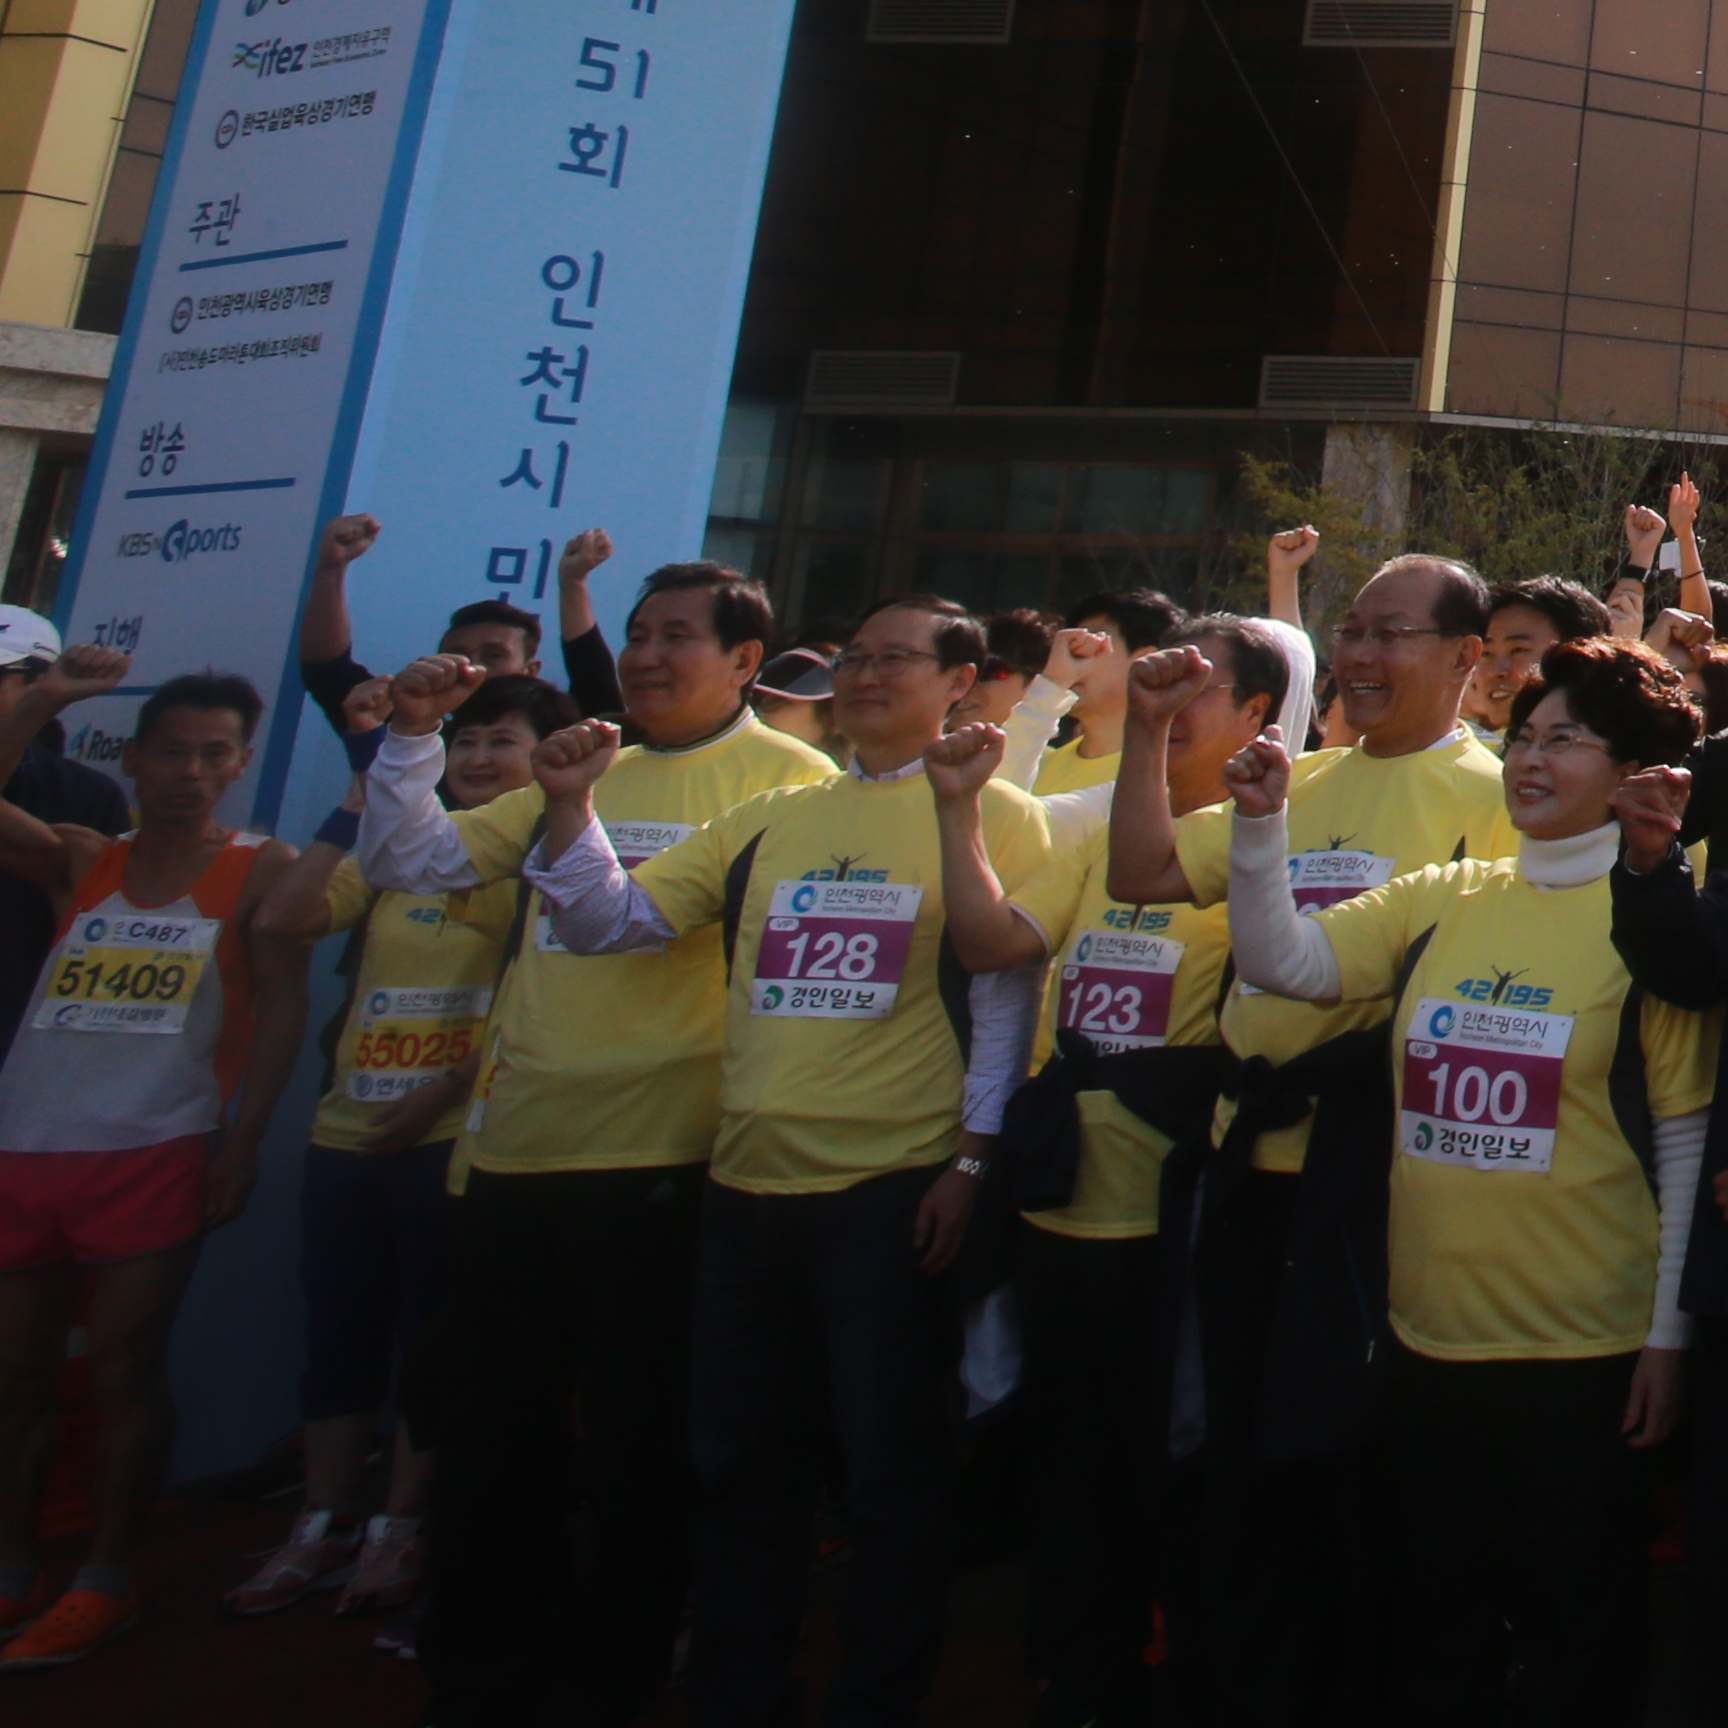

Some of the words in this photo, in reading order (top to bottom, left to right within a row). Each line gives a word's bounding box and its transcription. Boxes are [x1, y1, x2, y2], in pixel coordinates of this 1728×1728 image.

[189, 192, 241, 246] 주관
[139, 422, 185, 477] 방송
[824, 888, 901, 905] 인천광역시
[129, 922, 188, 943] C487
[776, 920, 793, 929] VIP
[785, 931, 879, 981] 128
[1096, 937, 1164, 957] 인천광역시
[57, 961, 185, 1000] 51409
[790, 986, 875, 1010] 경인일보
[1068, 982, 1142, 1033] 123
[1462, 1011, 1549, 1038] 인천광역시
[356, 1029, 473, 1068] 55025
[1415, 1045, 1430, 1055] VIP
[1428, 1063, 1527, 1125] 100
[1439, 1127, 1531, 1160] 경인일보
